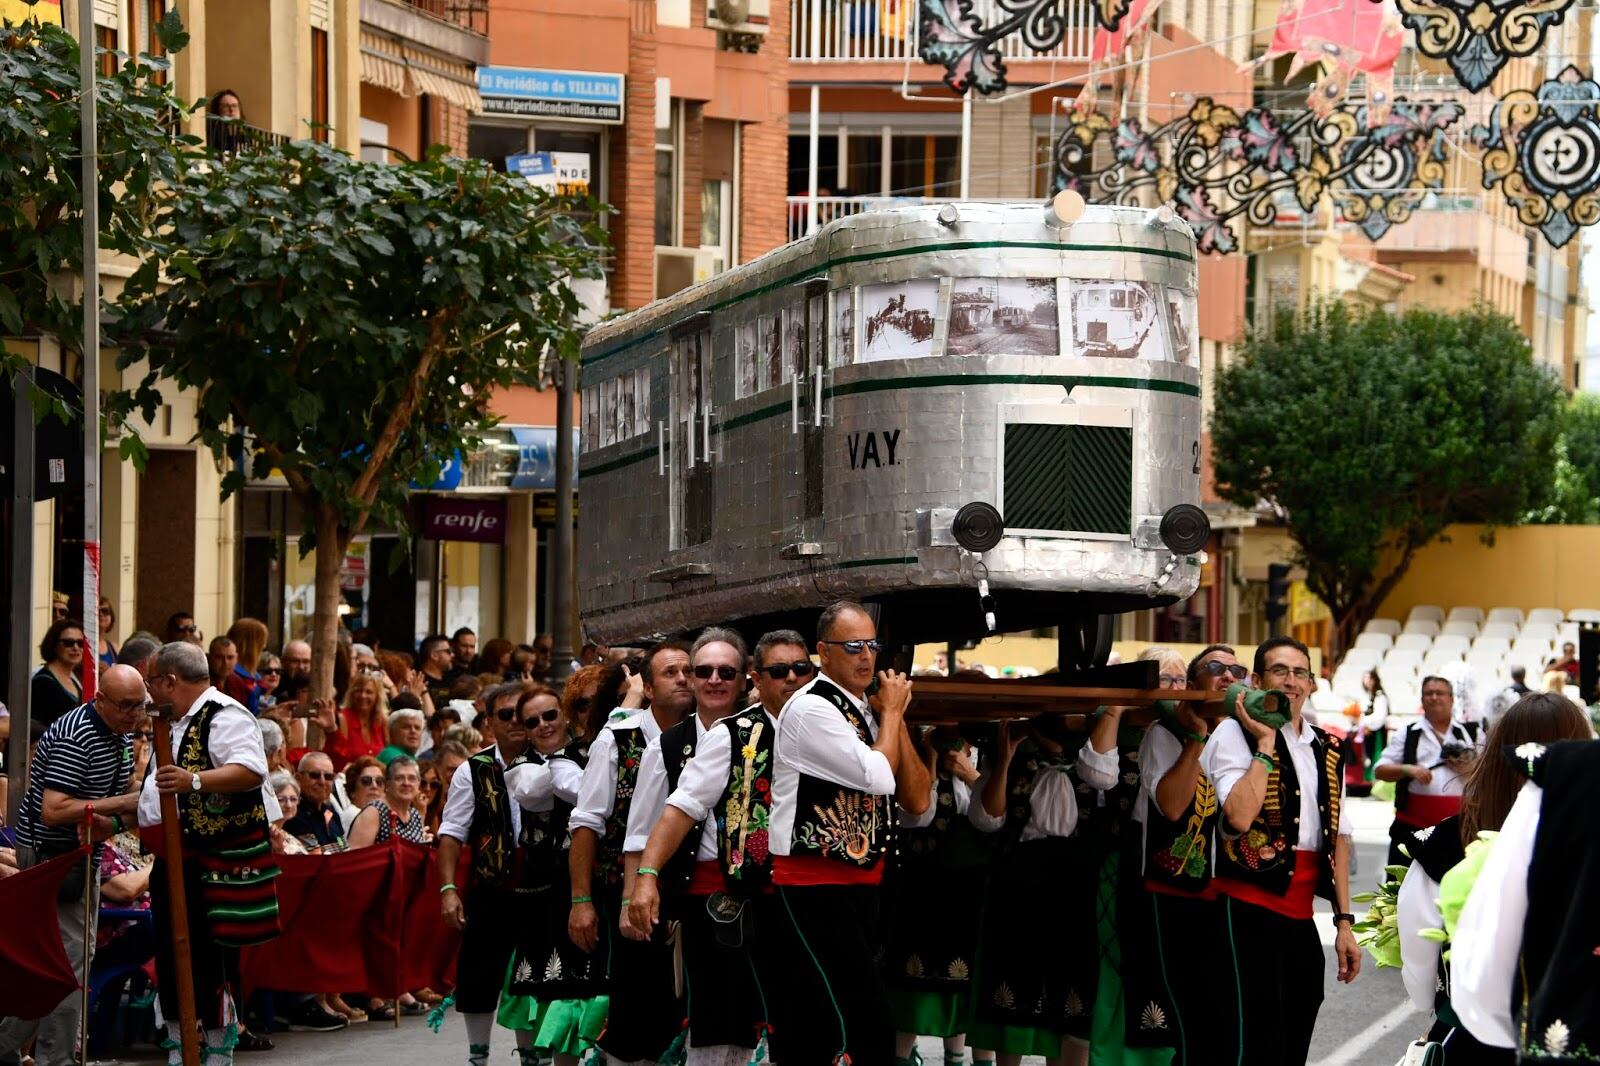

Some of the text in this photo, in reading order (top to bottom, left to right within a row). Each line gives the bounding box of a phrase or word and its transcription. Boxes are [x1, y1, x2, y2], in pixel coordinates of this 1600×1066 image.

[480, 74, 618, 97] El Periódico de VILLENA
[434, 509, 498, 534] renfe
